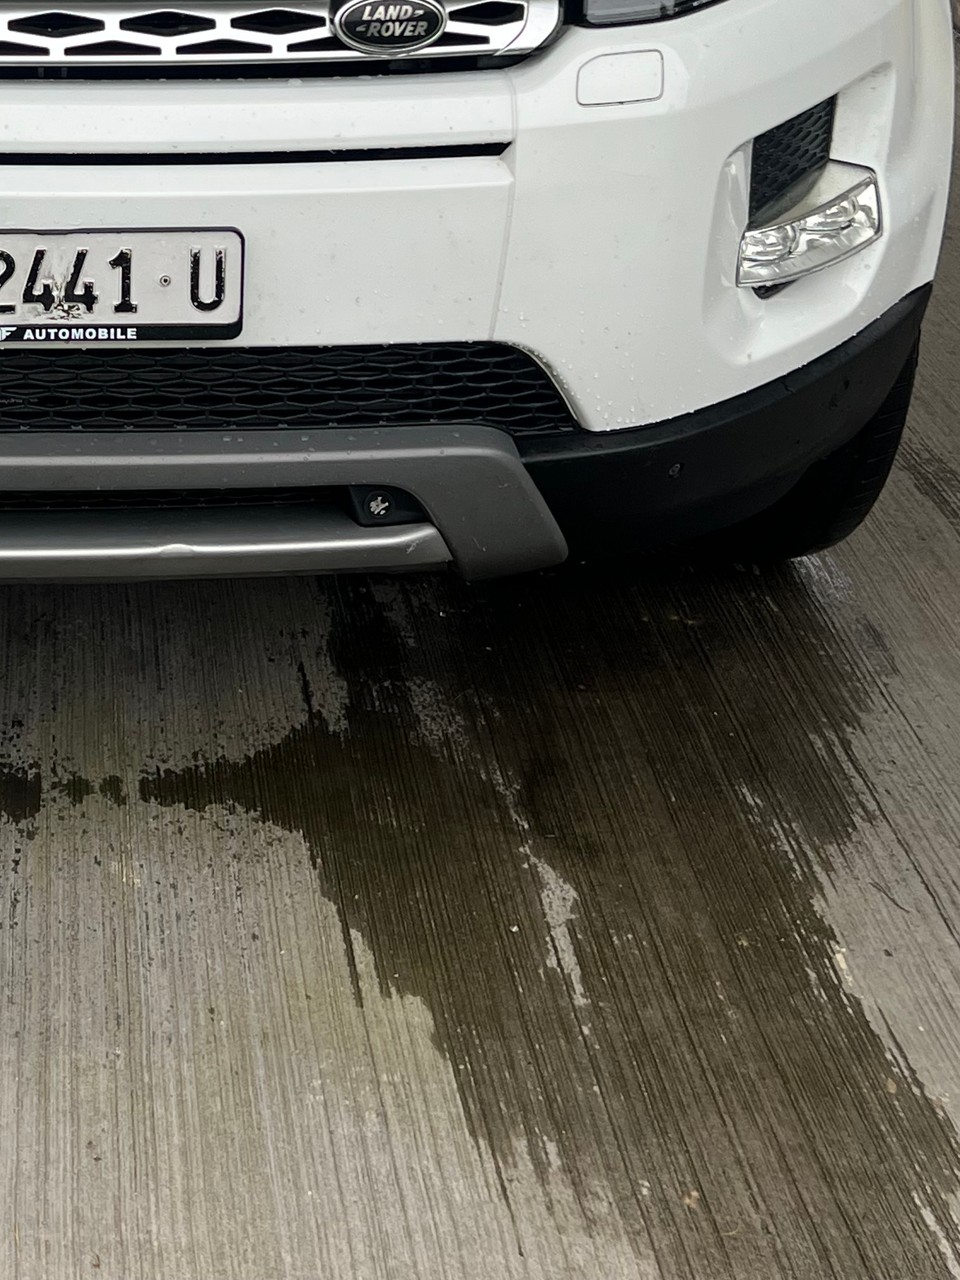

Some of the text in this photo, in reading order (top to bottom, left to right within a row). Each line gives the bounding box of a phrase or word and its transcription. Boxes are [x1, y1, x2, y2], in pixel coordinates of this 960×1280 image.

[361, 5, 414, 21] LAND
[366, 21, 429, 37] ROVER
[189, 248, 226, 312] U
[22, 327, 138, 340] AUTOMOBILE
